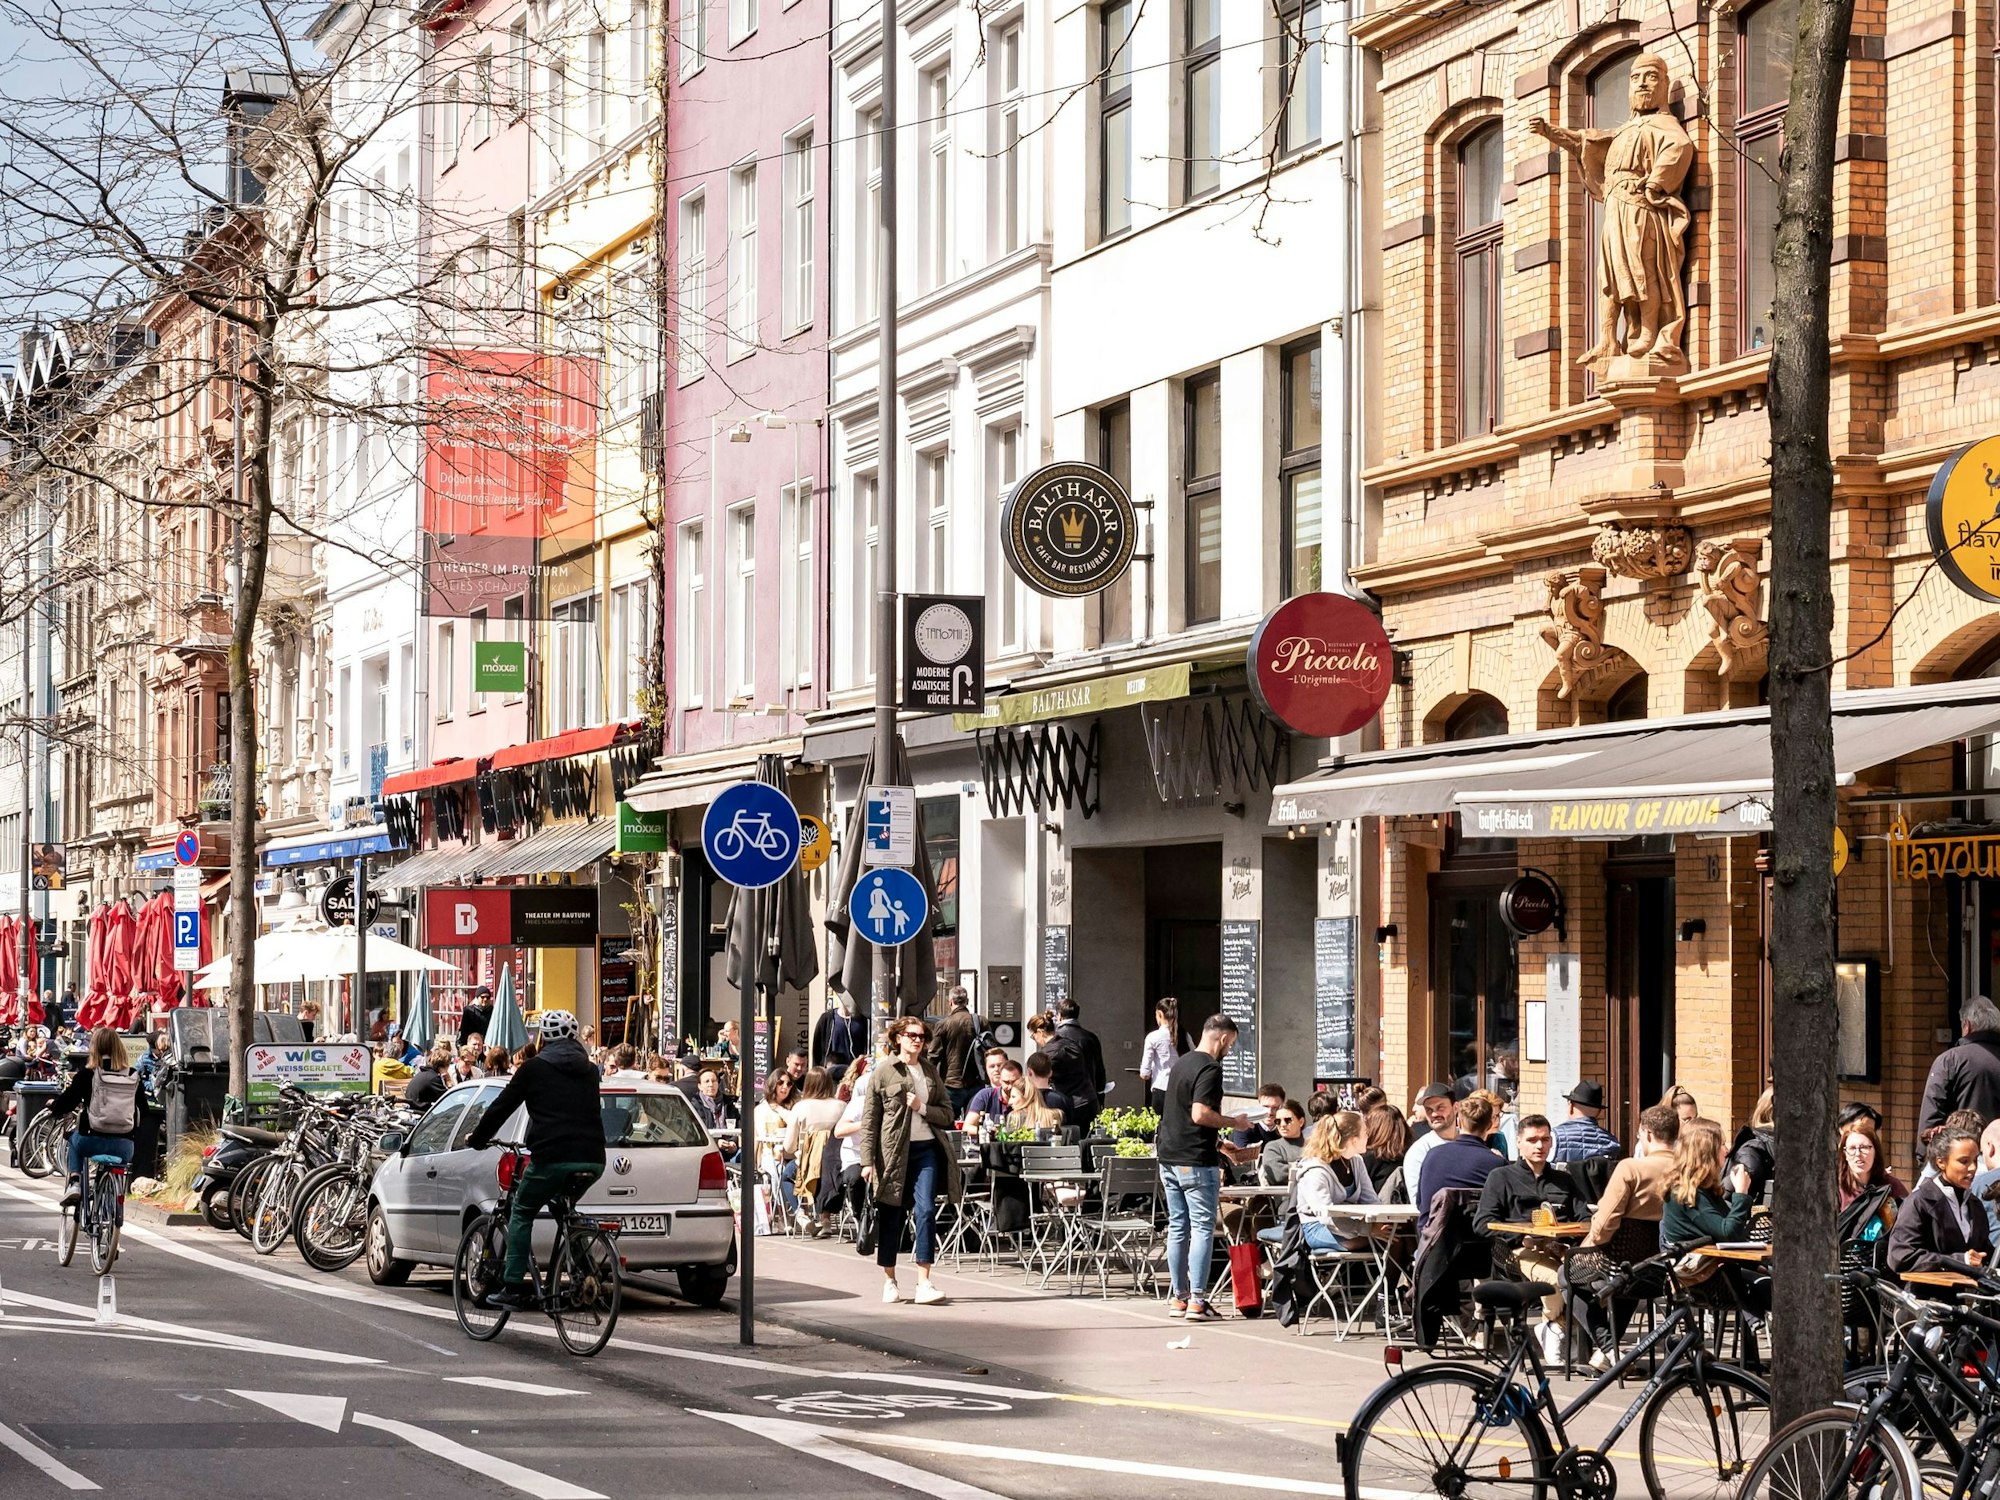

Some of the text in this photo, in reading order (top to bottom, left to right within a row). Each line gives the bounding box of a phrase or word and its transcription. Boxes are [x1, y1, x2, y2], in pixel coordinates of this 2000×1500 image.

[1029, 482, 1118, 533] BALTHASAR
[1036, 545, 1110, 574] CAFE BAR RESTAURANT
[437, 563, 569, 577] THEATER IM BAUTURM
[551, 583, 580, 596] KÖLN
[1271, 637, 1378, 674] Piccola
[916, 667, 950, 677] MODERNE
[912, 681, 950, 691] ASIATISCHE
[1294, 675, 1341, 687] L'Originale
[927, 692, 950, 704] KÜCHE
[1032, 687, 1091, 714] BALTHASAR
[1550, 803, 1630, 831] FLAVOUR
[1635, 799, 1662, 829] OF
[1662, 797, 1721, 826] INDIA
[1232, 856, 1251, 876] Gaffel
[1328, 855, 1349, 876] Gaffel
[1232, 877, 1252, 900] Kölsch
[1328, 878, 1350, 900] Kölsch
[327, 897, 377, 909] SALN
[1514, 896, 1550, 909] Piccola
[178, 915, 192, 943] P
[263, 1055, 277, 1067] Köln
[348, 1058, 361, 1070] Köln
[631, 1216, 664, 1230] 1621
